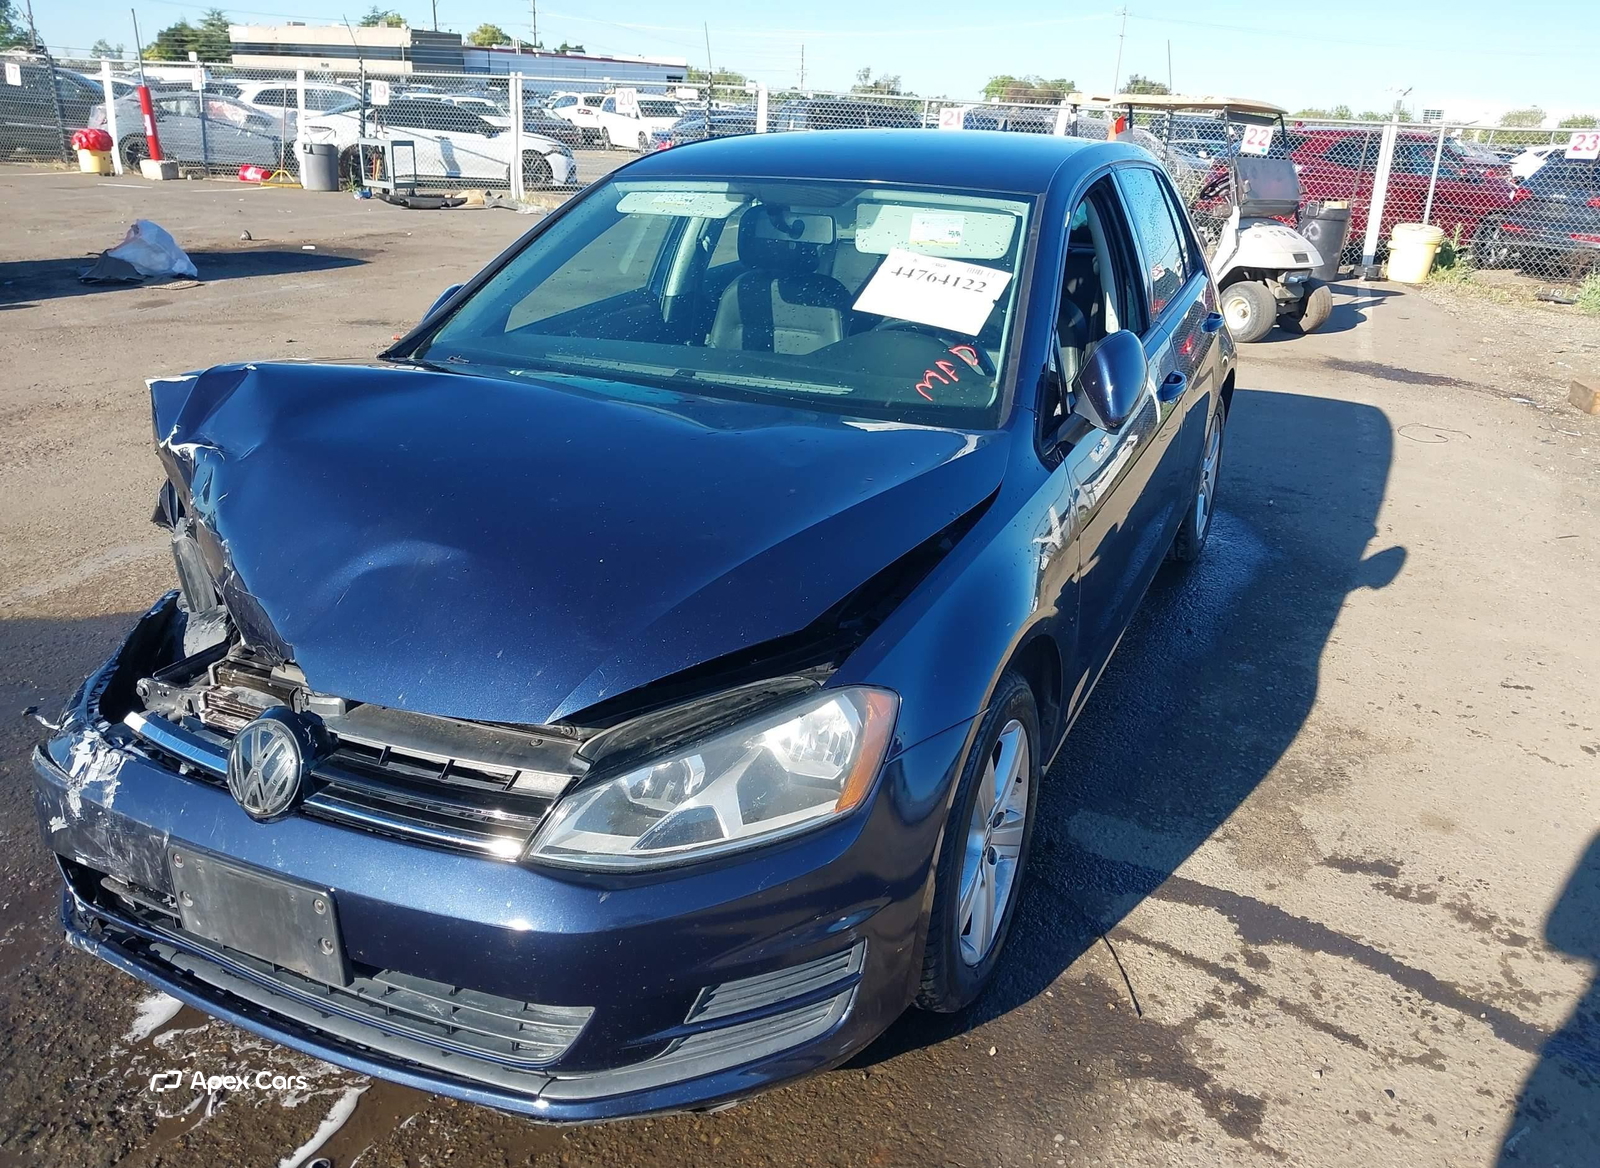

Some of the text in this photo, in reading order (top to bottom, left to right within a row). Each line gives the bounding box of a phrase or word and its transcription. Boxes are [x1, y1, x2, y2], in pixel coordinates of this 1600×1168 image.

[7, 66, 18, 79] 17
[374, 84, 387, 98] 19
[619, 90, 634, 106] 20
[943, 110, 961, 126] 21
[1246, 127, 1270, 147] 22
[1572, 133, 1600, 151] 23
[890, 265, 987, 293] 44764122
[230, 720, 300, 816] VW
